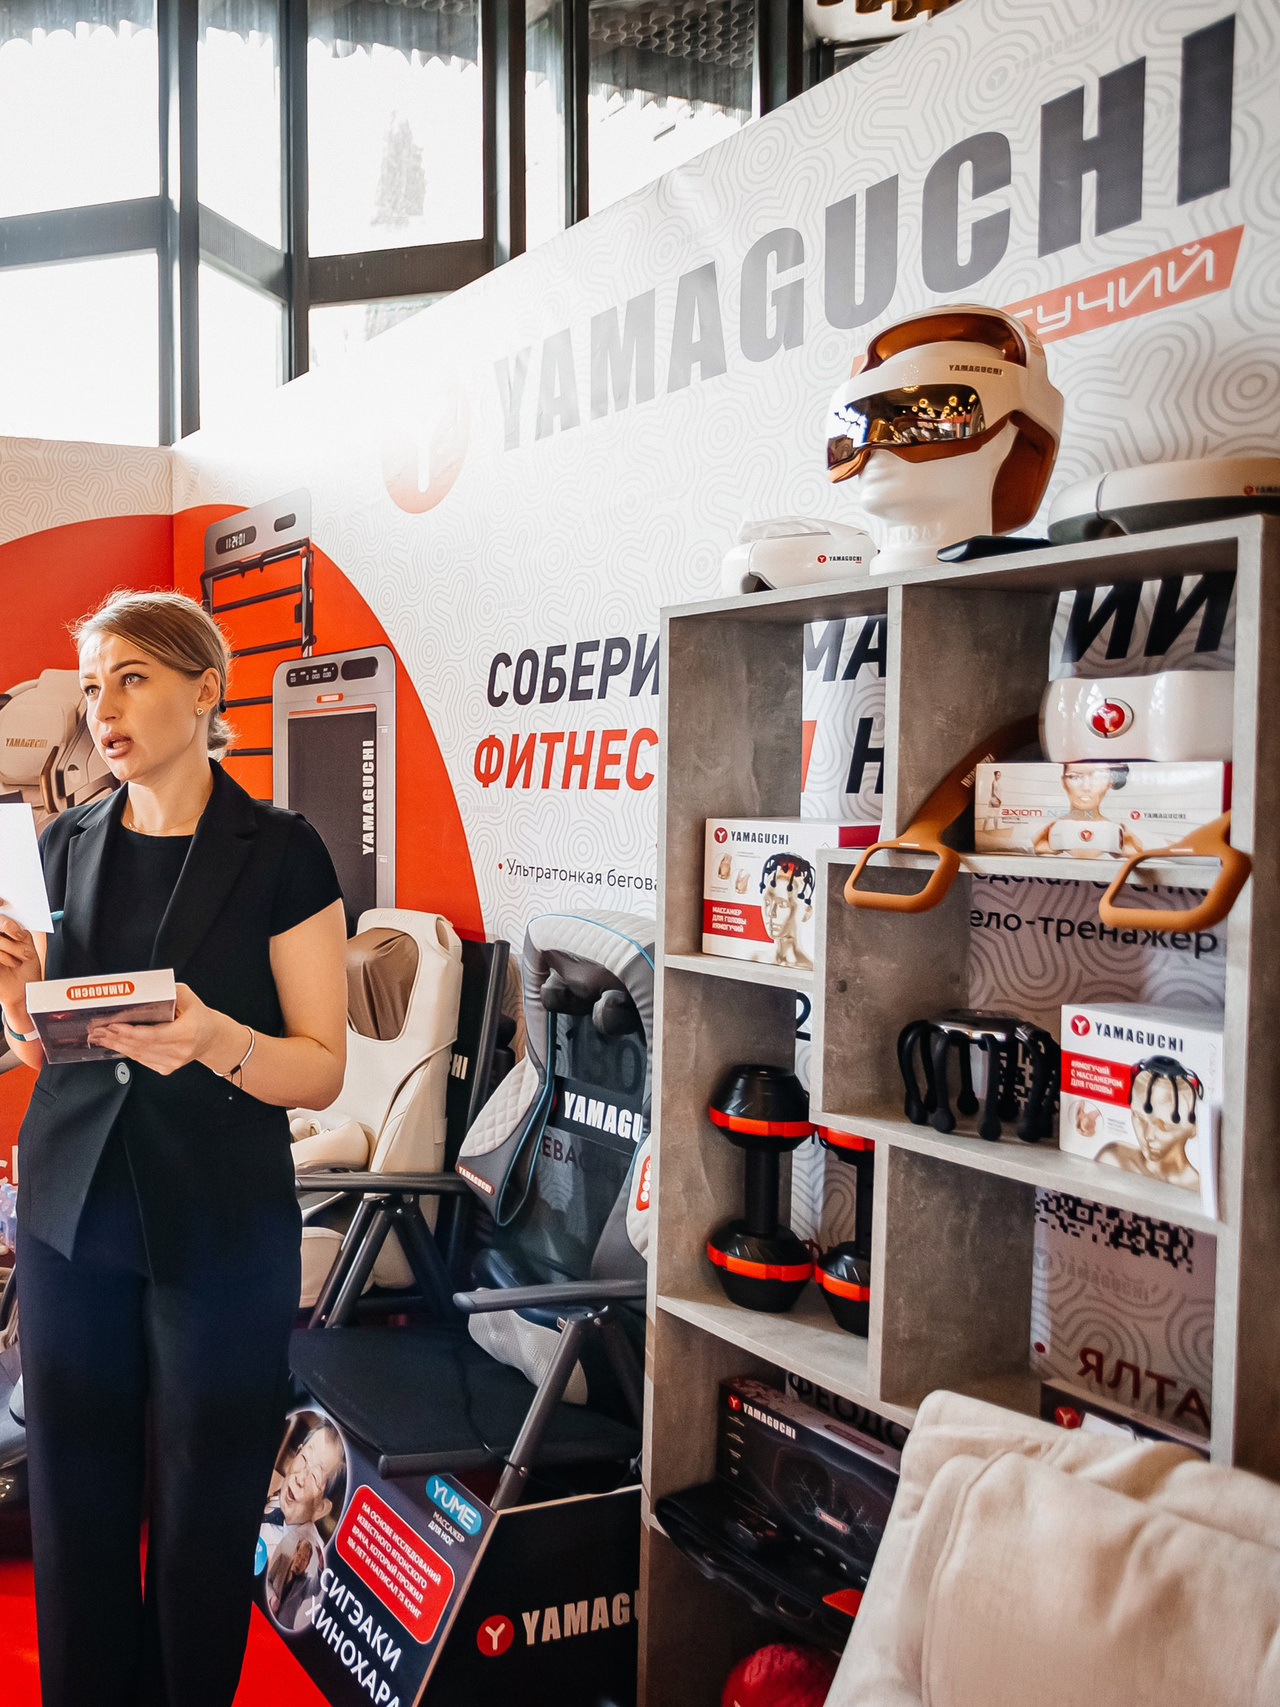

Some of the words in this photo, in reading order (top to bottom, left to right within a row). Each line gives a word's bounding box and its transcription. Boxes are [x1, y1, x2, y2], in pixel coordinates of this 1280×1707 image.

[493, 14, 1236, 452] YAMAGUCHI
[949, 364, 1003, 376] YAMAGUCHI
[5, 738, 48, 749] YAMAGUCHI
[473, 727, 659, 791] ФИТНЕС
[362, 740, 375, 856] YAMAGUCHI
[1002, 808, 1042, 817] axiom
[1143, 812, 1187, 820] YAMAGUCHI
[730, 830, 789, 845] YAMAGUCHI
[506, 858, 602, 886] Ультратонкая
[724, 915, 747, 925] ГОЛОВЫ
[70, 982, 131, 999] YAMAGUCHI
[1095, 1021, 1184, 1053] YAMAGUCHI
[1085, 1081, 1113, 1095] ГОЛОВЫ
[458, 1166, 492, 1194] YAMAGUCHI
[743, 1402, 796, 1440] YAMAGUCHI
[434, 1480, 476, 1530] YUME
[428, 1520, 442, 1536] ДЛЯ
[441, 1534, 455, 1547] НОГ
[433, 1511, 465, 1542] МАССАЖЕР
[357, 1514, 391, 1551] ИЗВЕСТНОГО
[391, 1546, 427, 1589] ЯПОНСКОГО
[362, 1502, 371, 1514] НА
[371, 1511, 393, 1537] ОСНОВЕ
[392, 1531, 441, 1585] ИССЛЕДОВАНИЙ
[352, 1525, 369, 1548] ВРАЧА,
[369, 1544, 398, 1576] КОТОРЫЙ
[396, 1569, 424, 1604] ПРОЖИЛ
[355, 1544, 366, 1560] ЛЕТ
[370, 1562, 398, 1597] НАПИСАЛ
[404, 1597, 422, 1619] КНИГ
[320, 1567, 402, 1672] СИГЭАКИ
